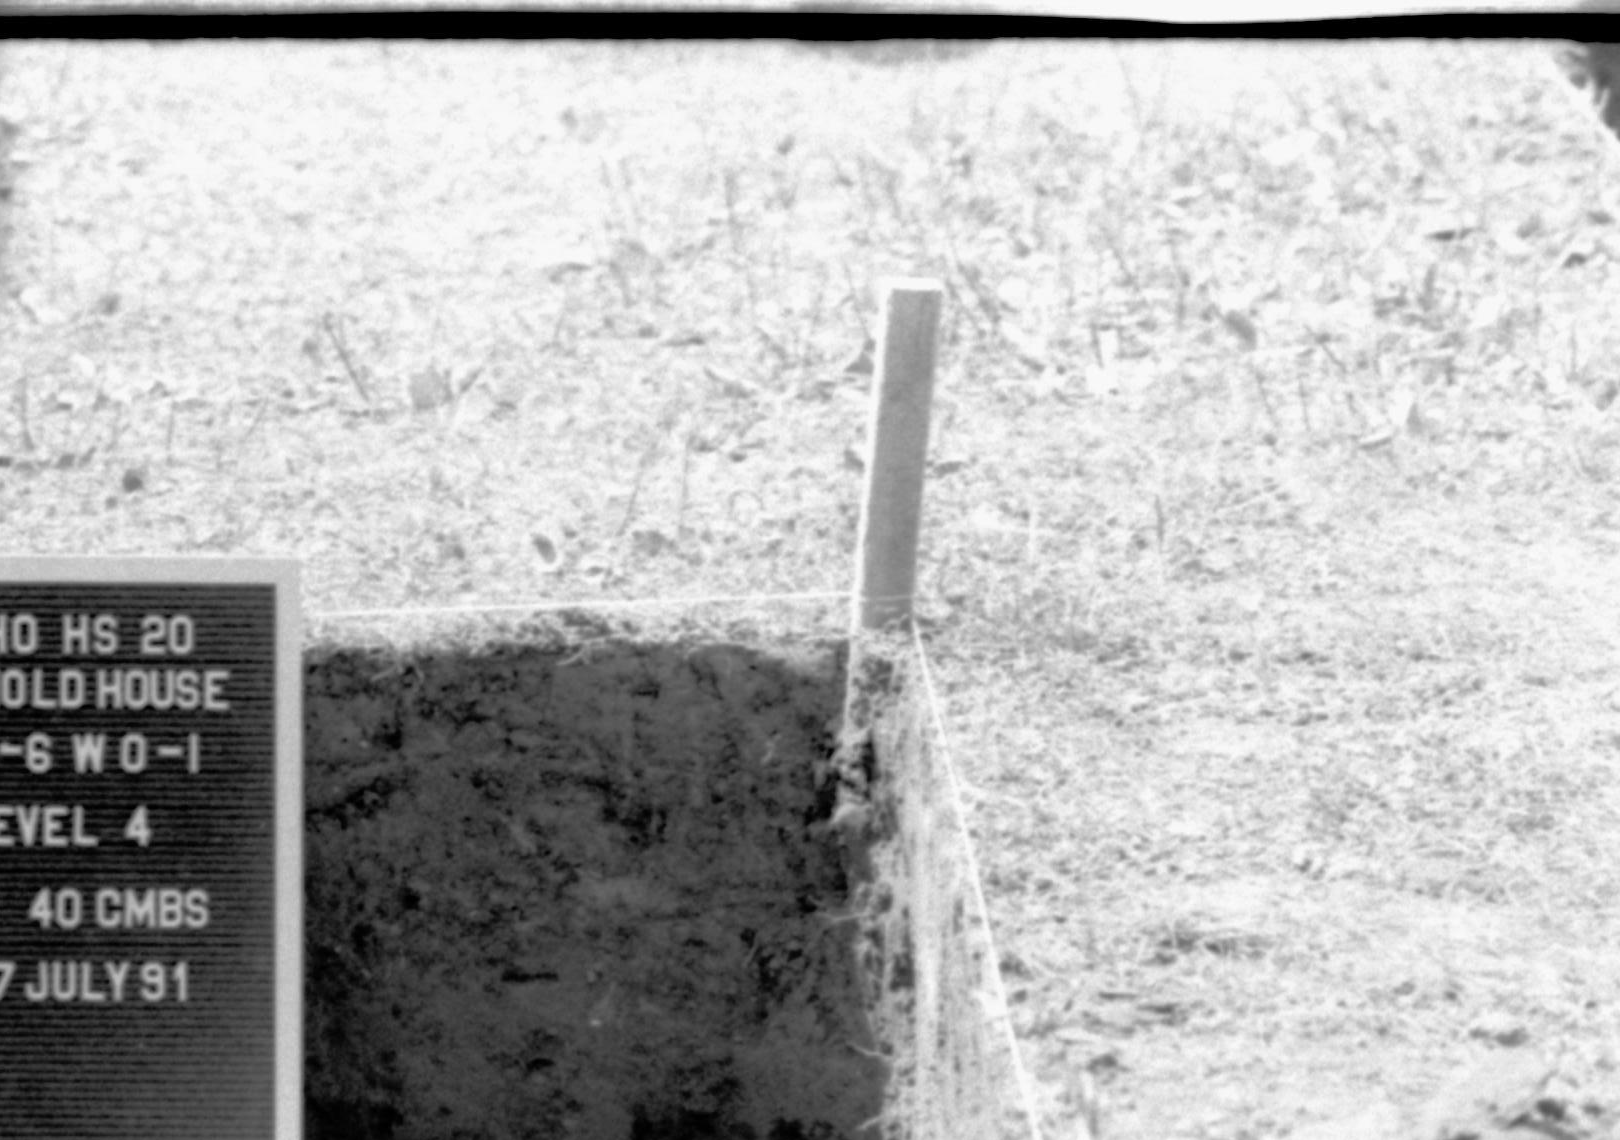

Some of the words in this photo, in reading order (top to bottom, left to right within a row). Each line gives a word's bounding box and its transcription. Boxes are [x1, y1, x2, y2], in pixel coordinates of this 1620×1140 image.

[62, 614, 119, 654] HS
[140, 614, 195, 655] 20
[96, 668, 230, 710] HOUSE
[125, 806, 152, 846] 4
[29, 887, 83, 928] 40
[95, 887, 210, 929] CMBS
[25, 961, 130, 1002] JULY
[139, 961, 190, 1002] 91
